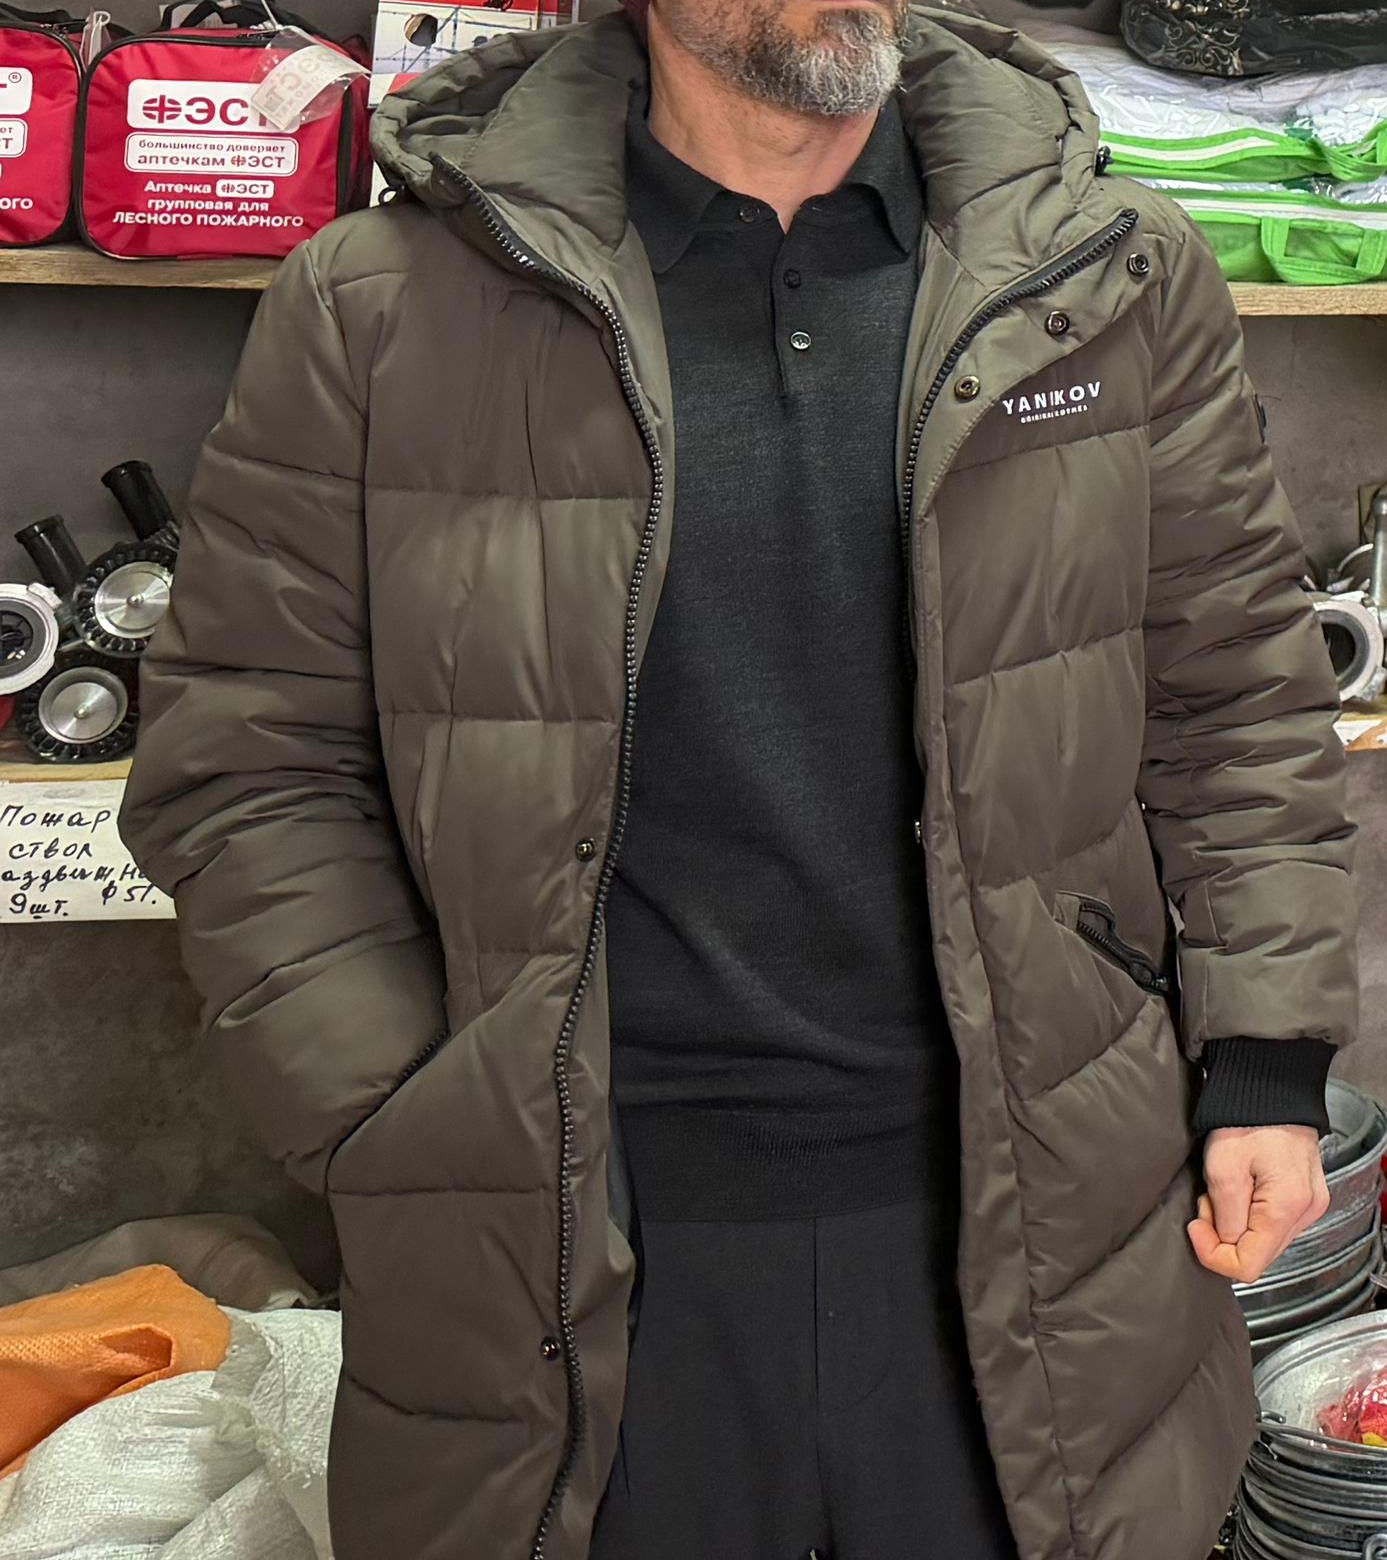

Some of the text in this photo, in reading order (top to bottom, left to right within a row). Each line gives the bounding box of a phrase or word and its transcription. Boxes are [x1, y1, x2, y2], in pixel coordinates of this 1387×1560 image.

[139, 139, 286, 155] большинство доверяет
[137, 154, 286, 169] аптечкам ФЭСТ
[144, 180, 270, 195] Аптечка ФЭСТ
[147, 198, 269, 212] групповая для
[113, 211, 304, 228] ЛЕСНОГО ПОЖАРНОГО
